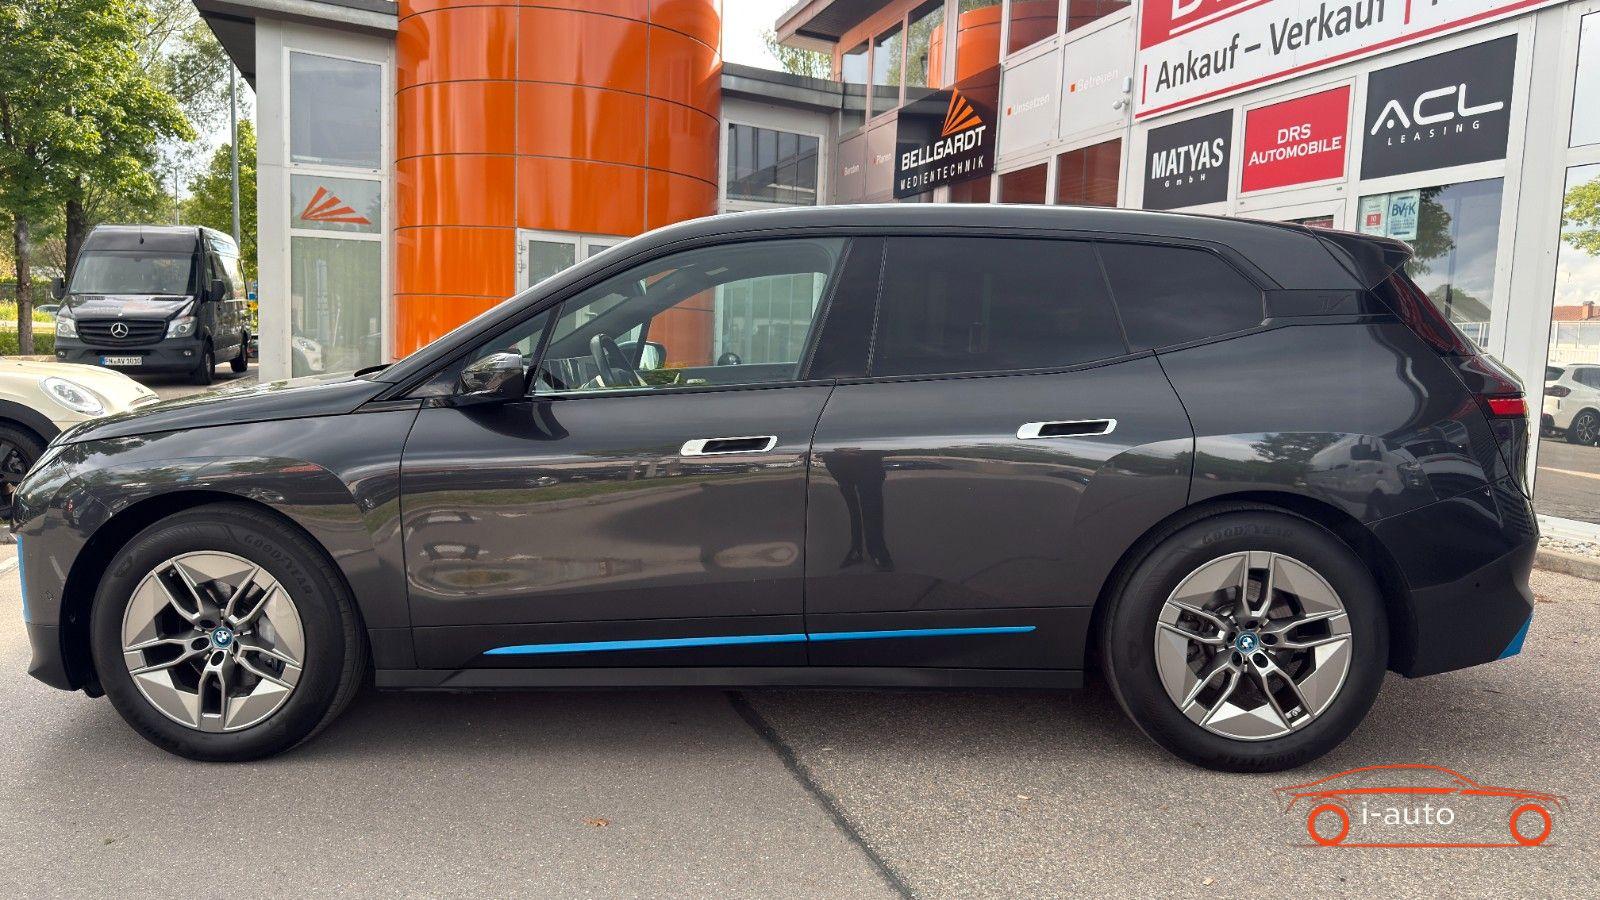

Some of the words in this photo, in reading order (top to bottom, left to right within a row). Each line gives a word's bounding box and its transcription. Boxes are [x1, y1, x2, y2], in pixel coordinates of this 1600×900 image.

[1155, 33, 1240, 93] Ankauf
[1370, 83, 1504, 136] ACL
[902, 125, 986, 171] BELLGARDT
[1277, 124, 1312, 145] DRS
[1387, 120, 1480, 146] LEASING
[901, 155, 984, 191] MEDIENTECHNIK
[1152, 138, 1225, 180] MATYAS
